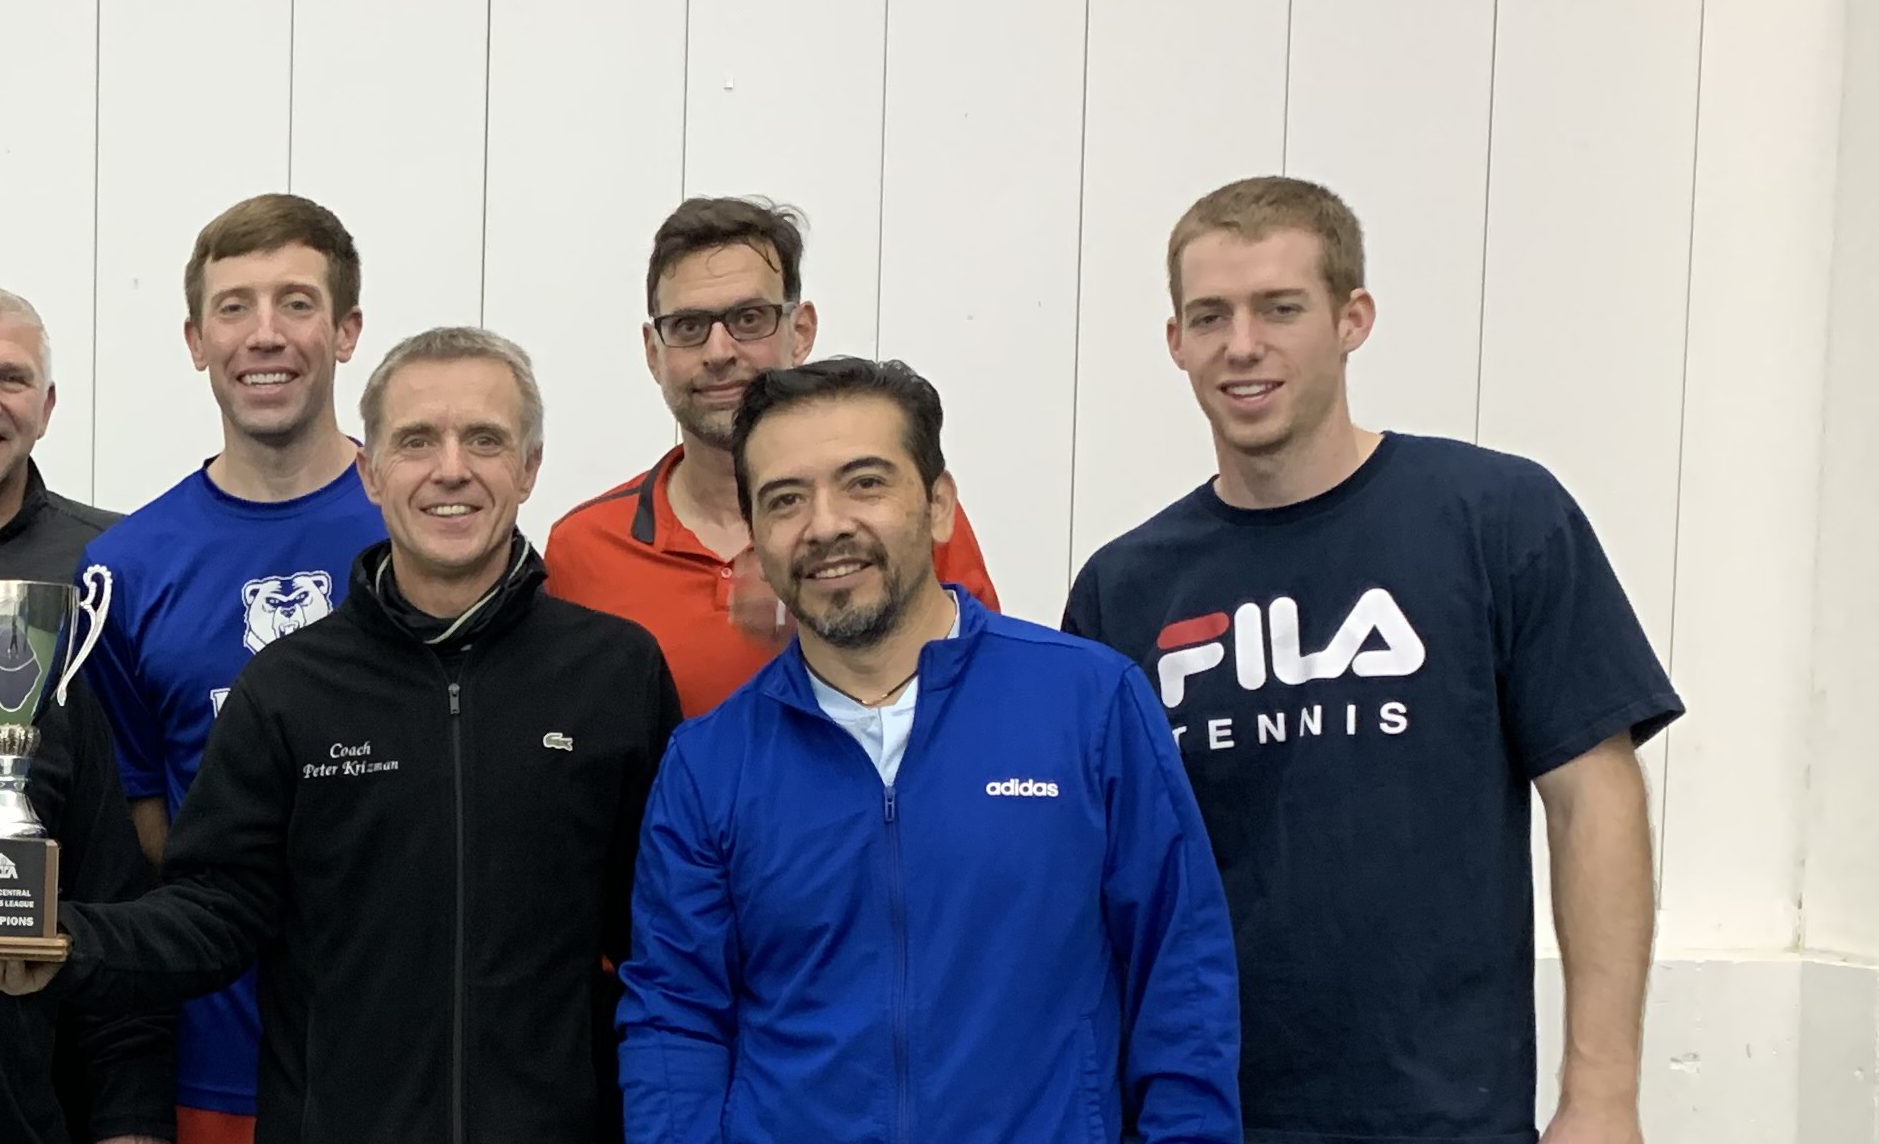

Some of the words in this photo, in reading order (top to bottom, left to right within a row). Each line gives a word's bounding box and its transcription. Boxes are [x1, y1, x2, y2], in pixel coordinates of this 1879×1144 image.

[1156, 587, 1426, 708] FILA
[329, 740, 371, 758] Coach
[303, 763, 338, 779] Peter
[342, 760, 399, 776] Krizman
[986, 778, 1059, 797] adidas
[4, 900, 34, 908] LEAGUE
